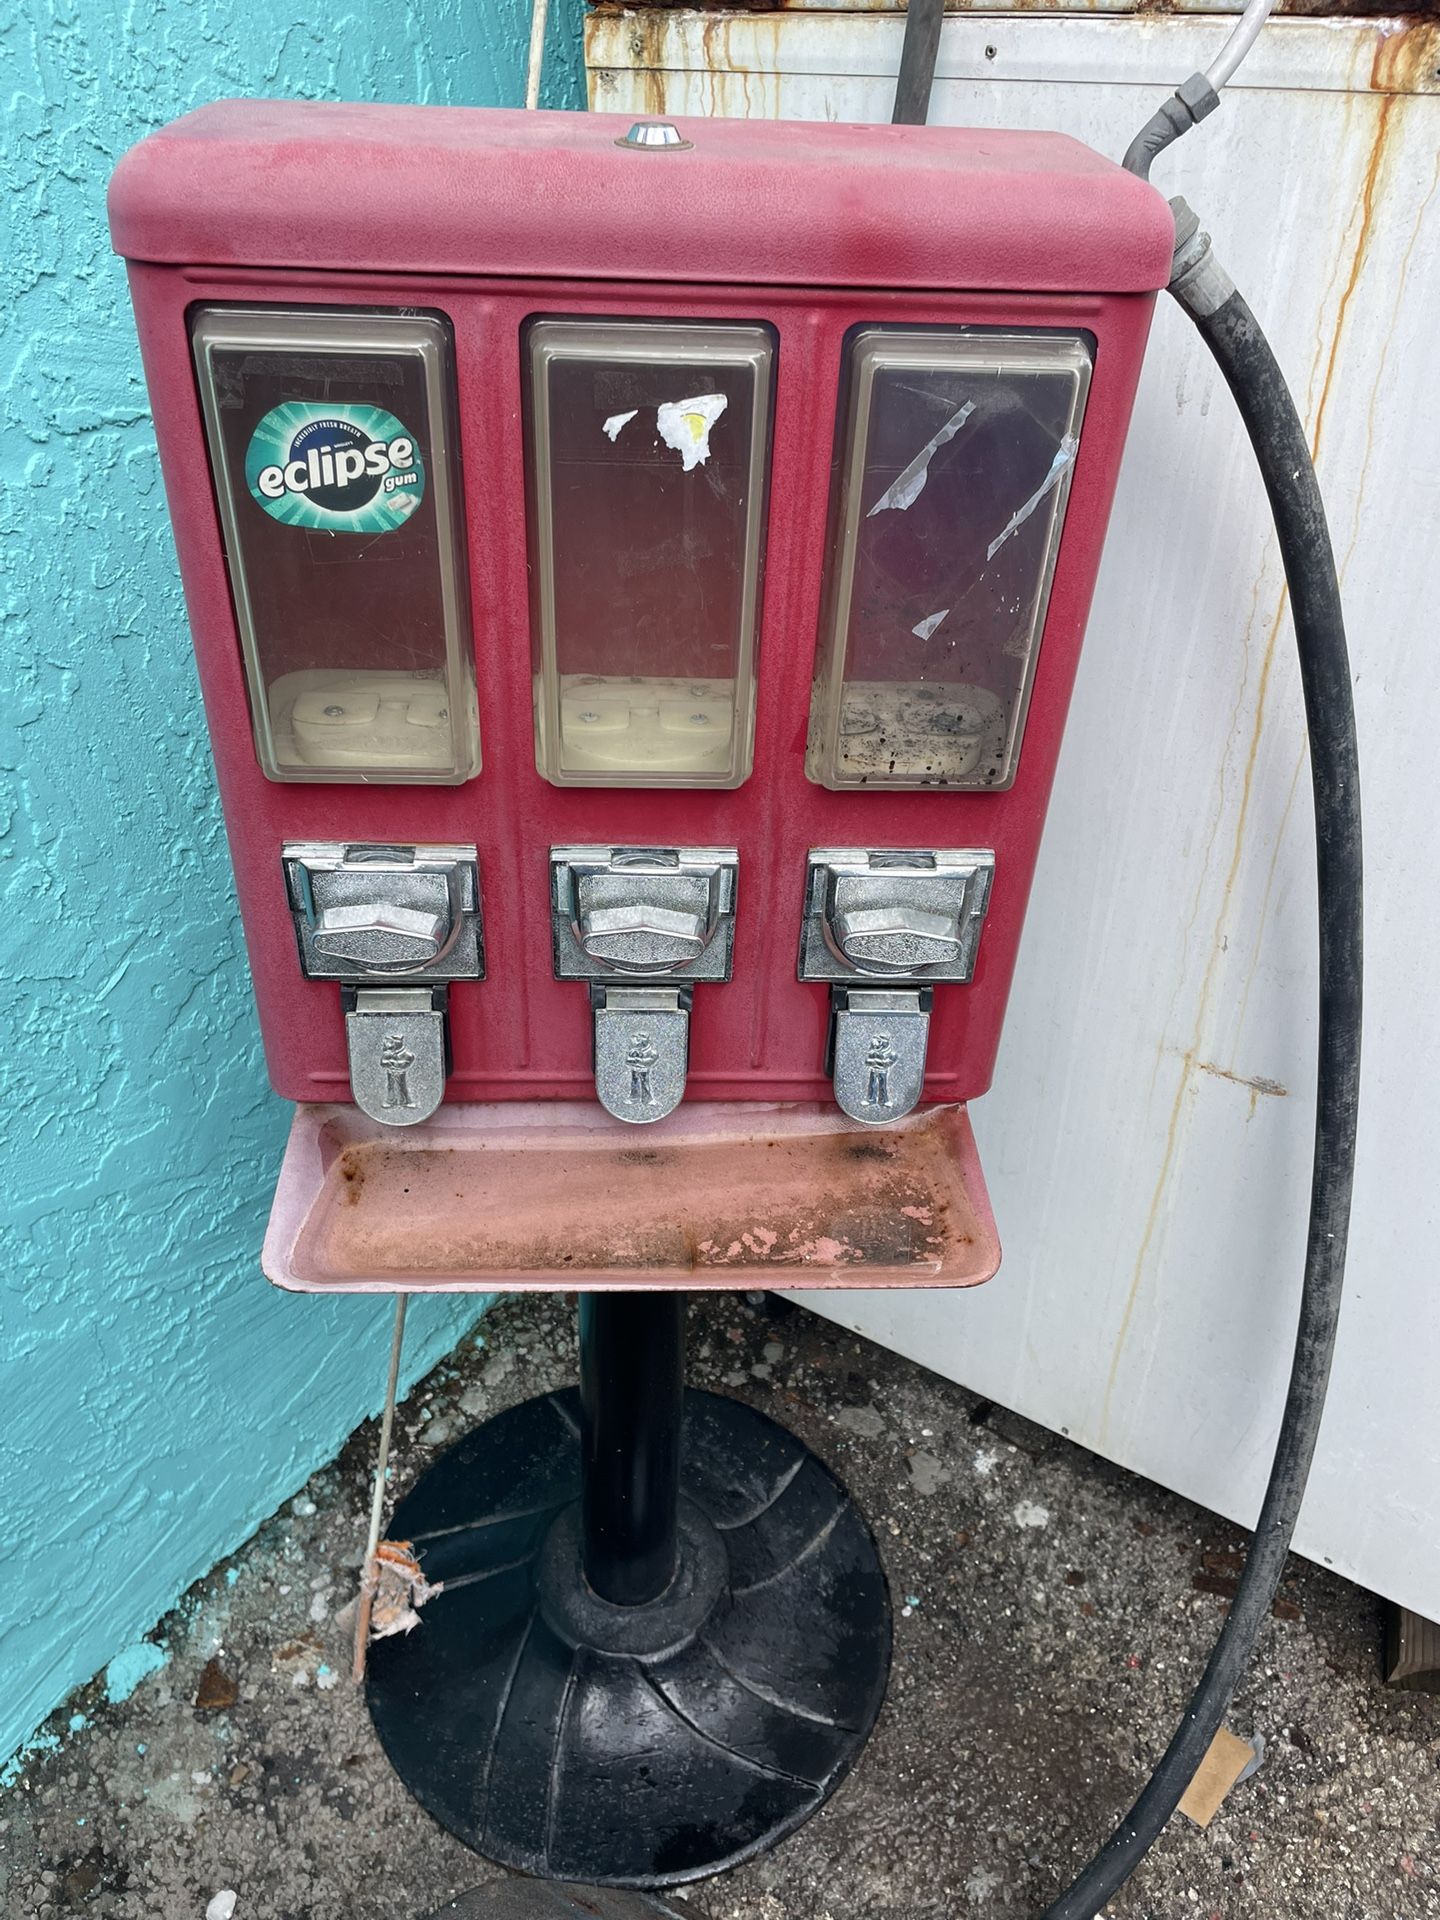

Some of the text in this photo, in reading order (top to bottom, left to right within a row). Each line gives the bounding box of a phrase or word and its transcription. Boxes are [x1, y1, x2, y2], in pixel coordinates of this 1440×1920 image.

[319, 421, 339, 429] FRESH
[339, 422, 362, 438] BREATH
[258, 437, 413, 498] eclipse
[385, 472, 417, 492] gum
